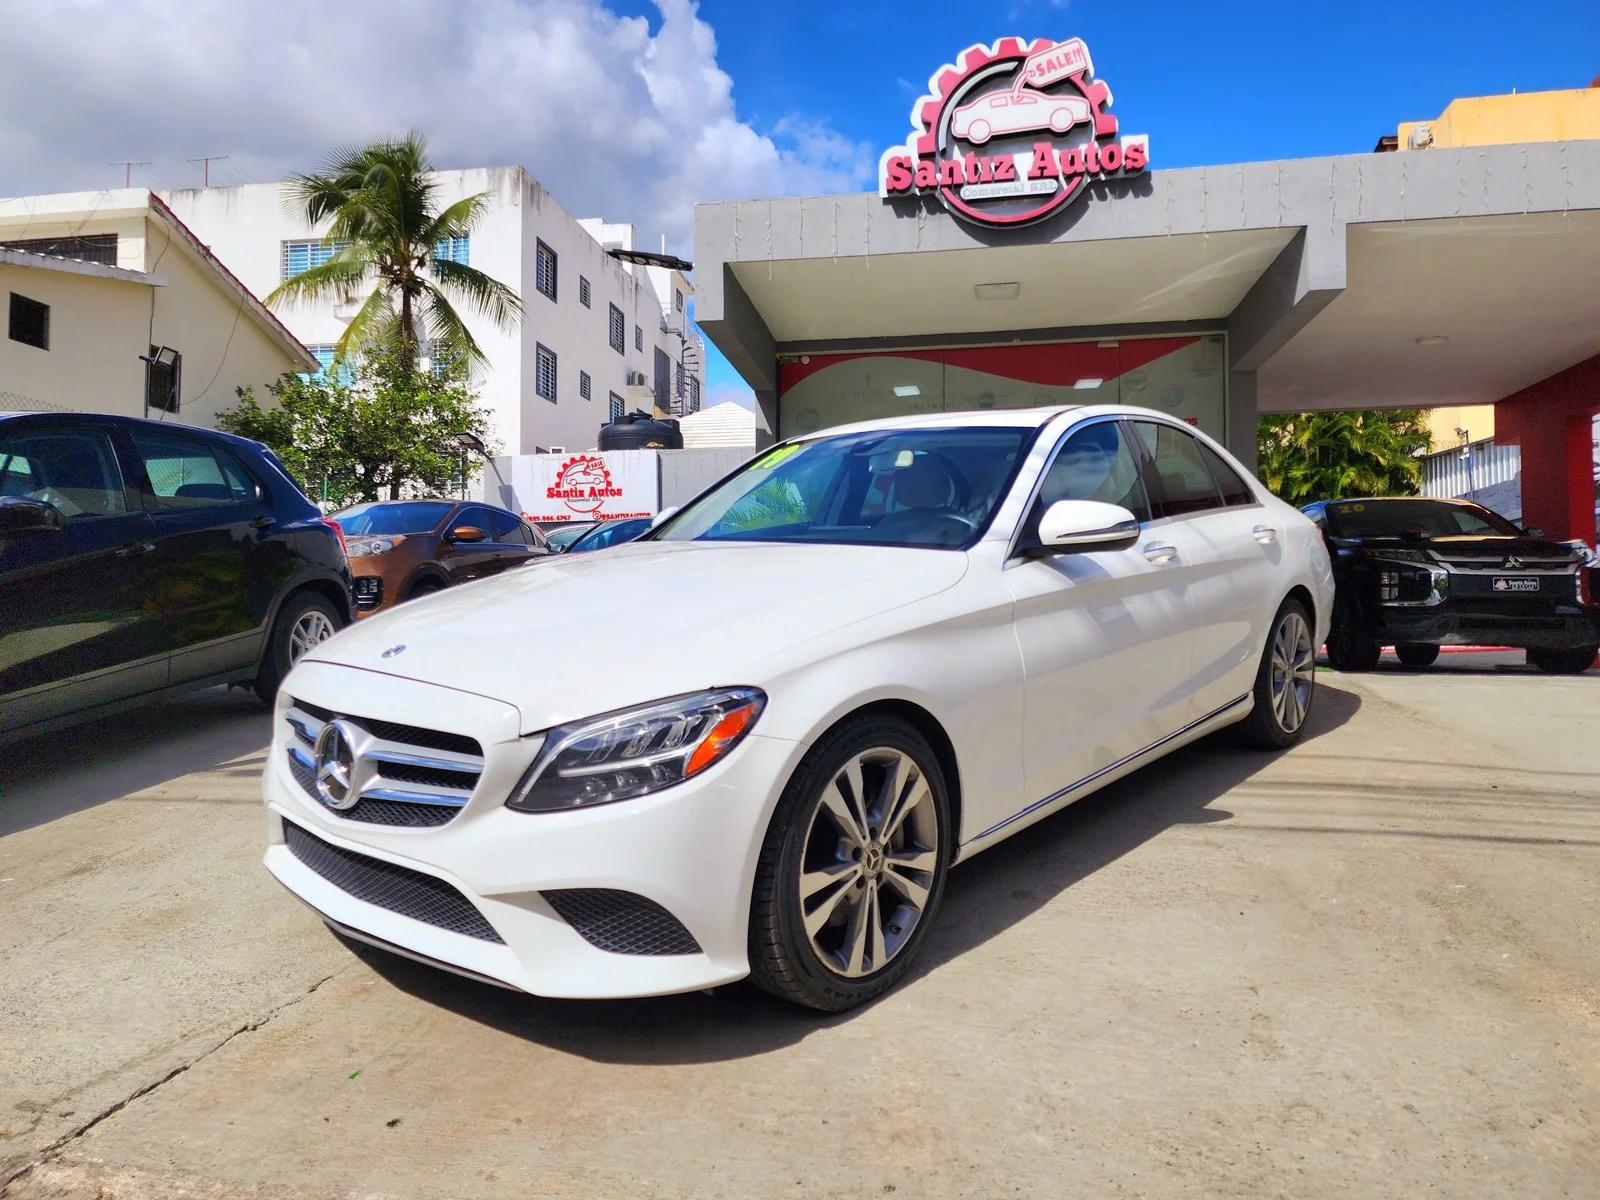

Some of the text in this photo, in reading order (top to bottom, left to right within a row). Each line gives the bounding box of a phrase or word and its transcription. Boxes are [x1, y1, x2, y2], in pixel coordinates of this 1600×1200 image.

[1028, 141, 1147, 178] Autos
[547, 487, 622, 498] Santiz Autos
